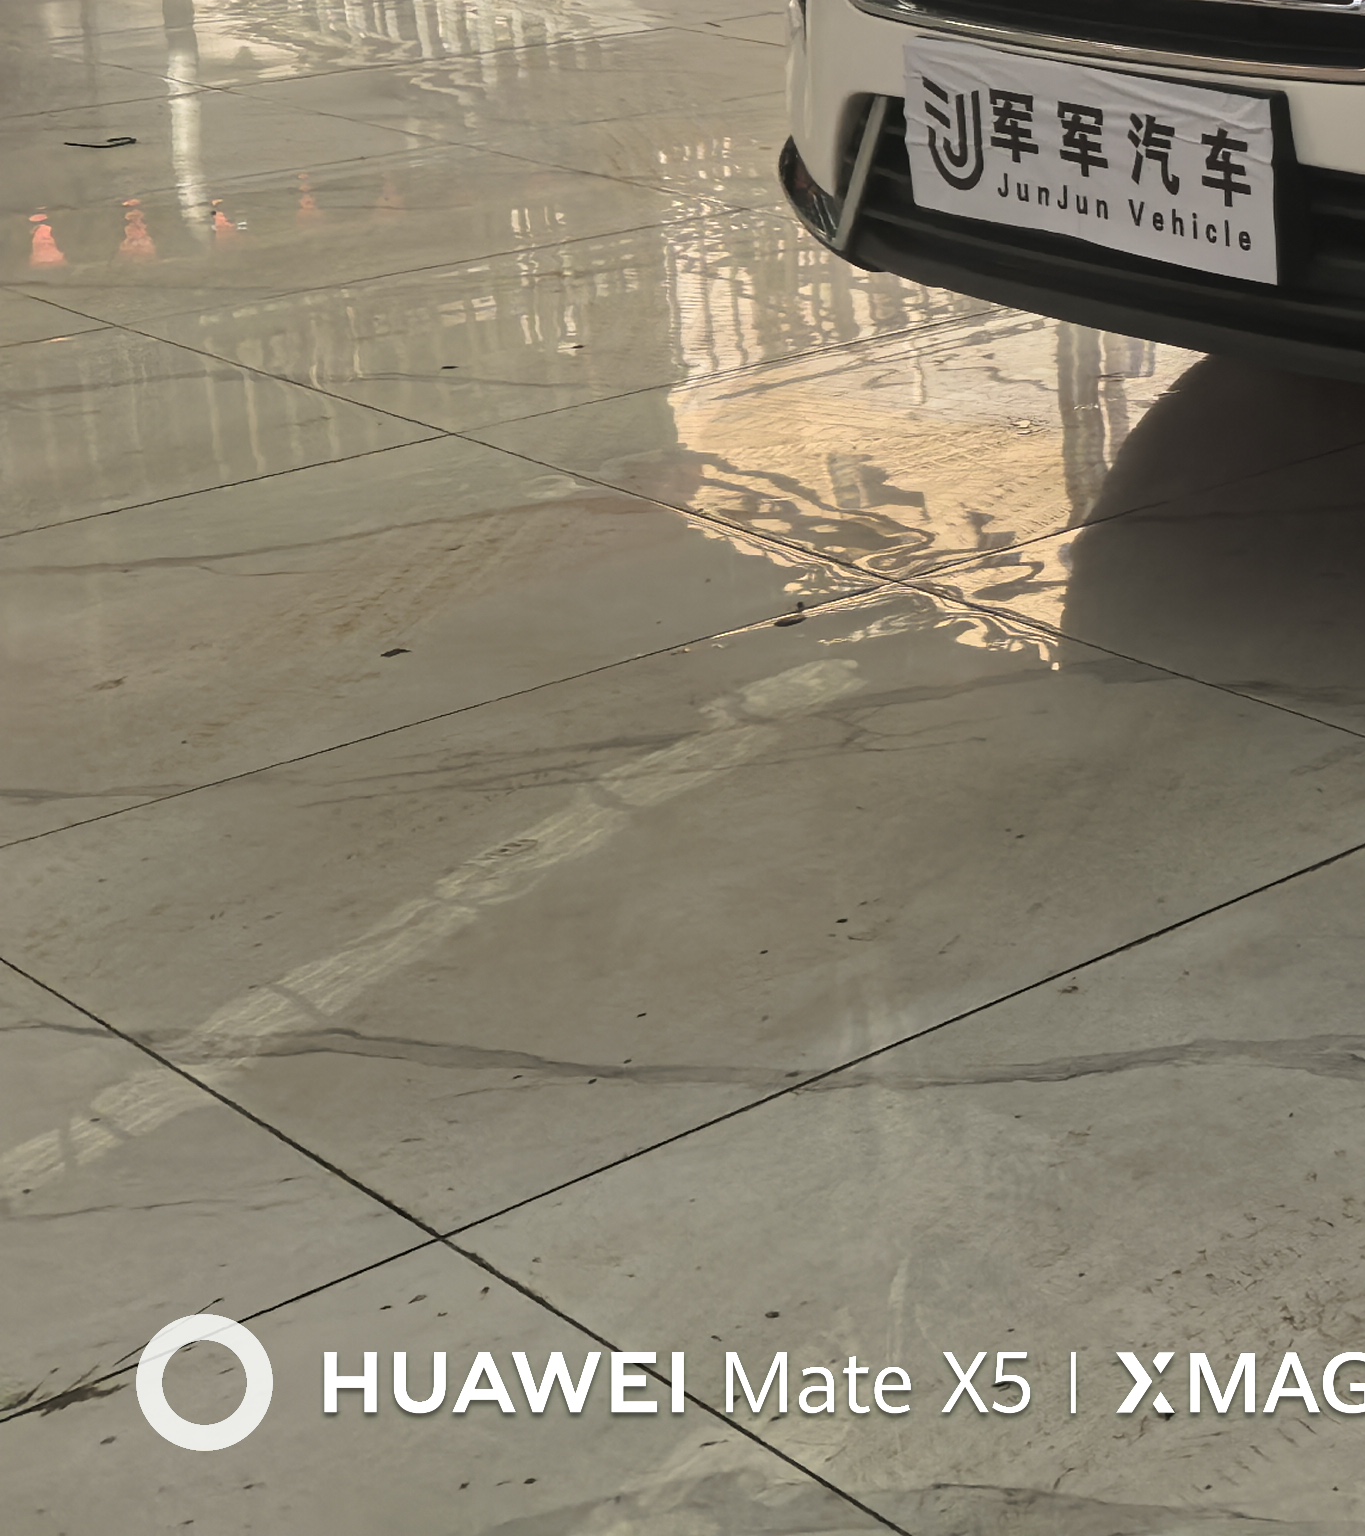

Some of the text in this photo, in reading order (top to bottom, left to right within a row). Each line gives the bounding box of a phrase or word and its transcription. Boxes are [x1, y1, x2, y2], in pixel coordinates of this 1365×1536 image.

[989, 88, 1252, 208] 军军汽车
[997, 173, 1252, 252] JunJun Vehicle
